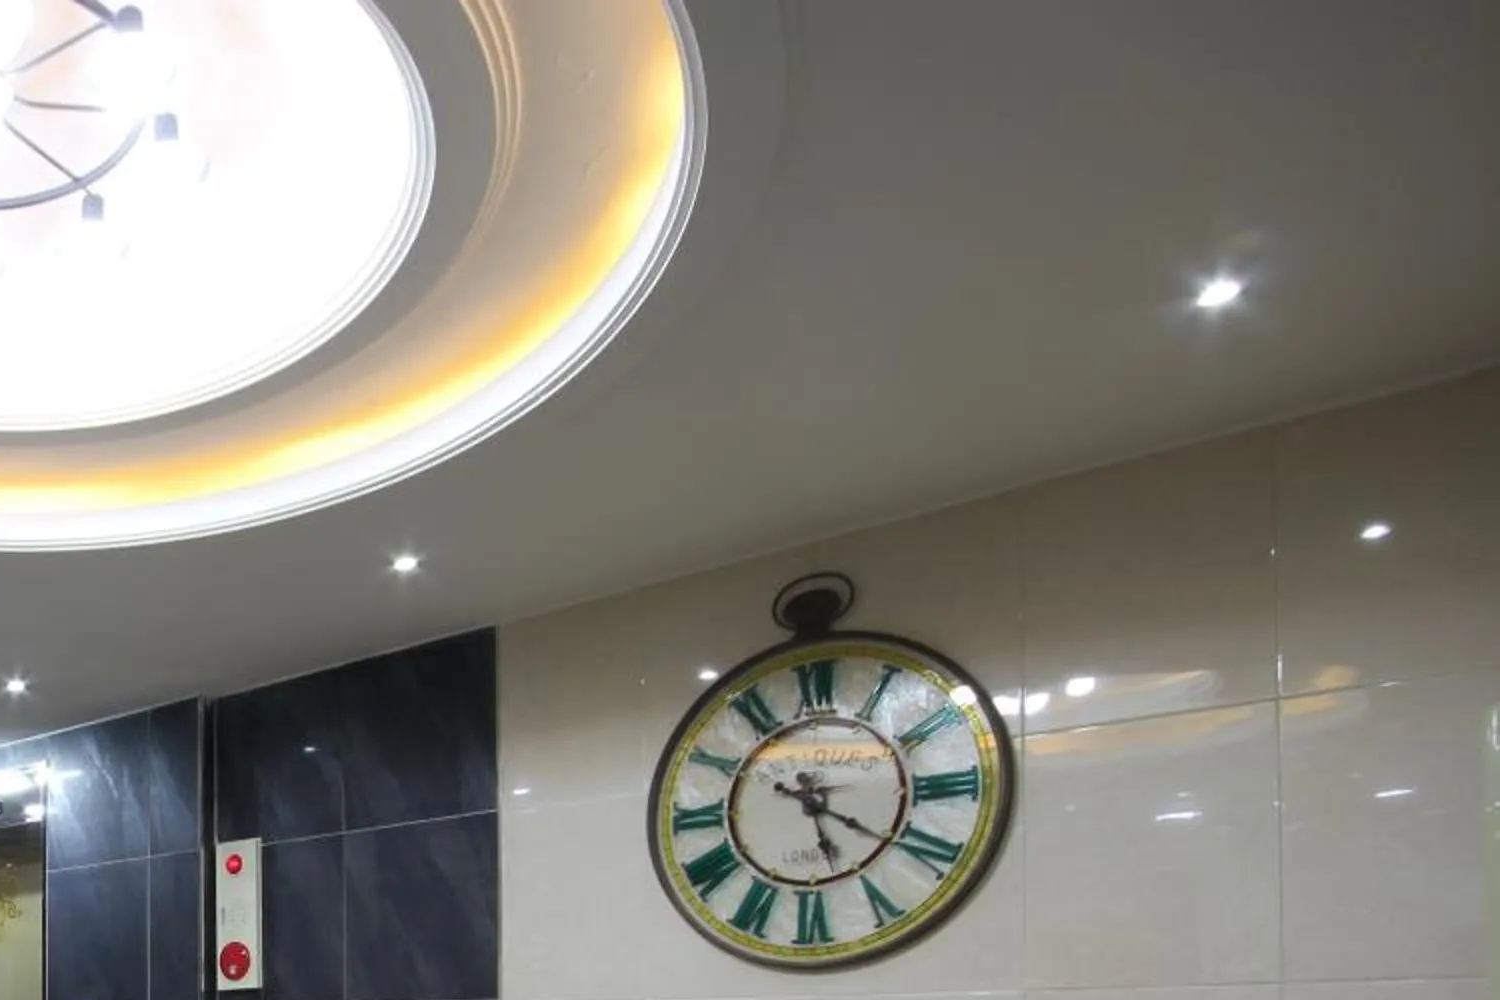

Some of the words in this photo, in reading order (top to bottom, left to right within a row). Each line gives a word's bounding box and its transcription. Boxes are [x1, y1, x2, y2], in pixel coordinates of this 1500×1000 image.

[854, 664, 902, 722] I
[911, 765, 979, 806] III
[672, 797, 725, 836] IX
[780, 845, 834, 863] LOND
[791, 890, 836, 945] VI
[858, 874, 906, 929] V
